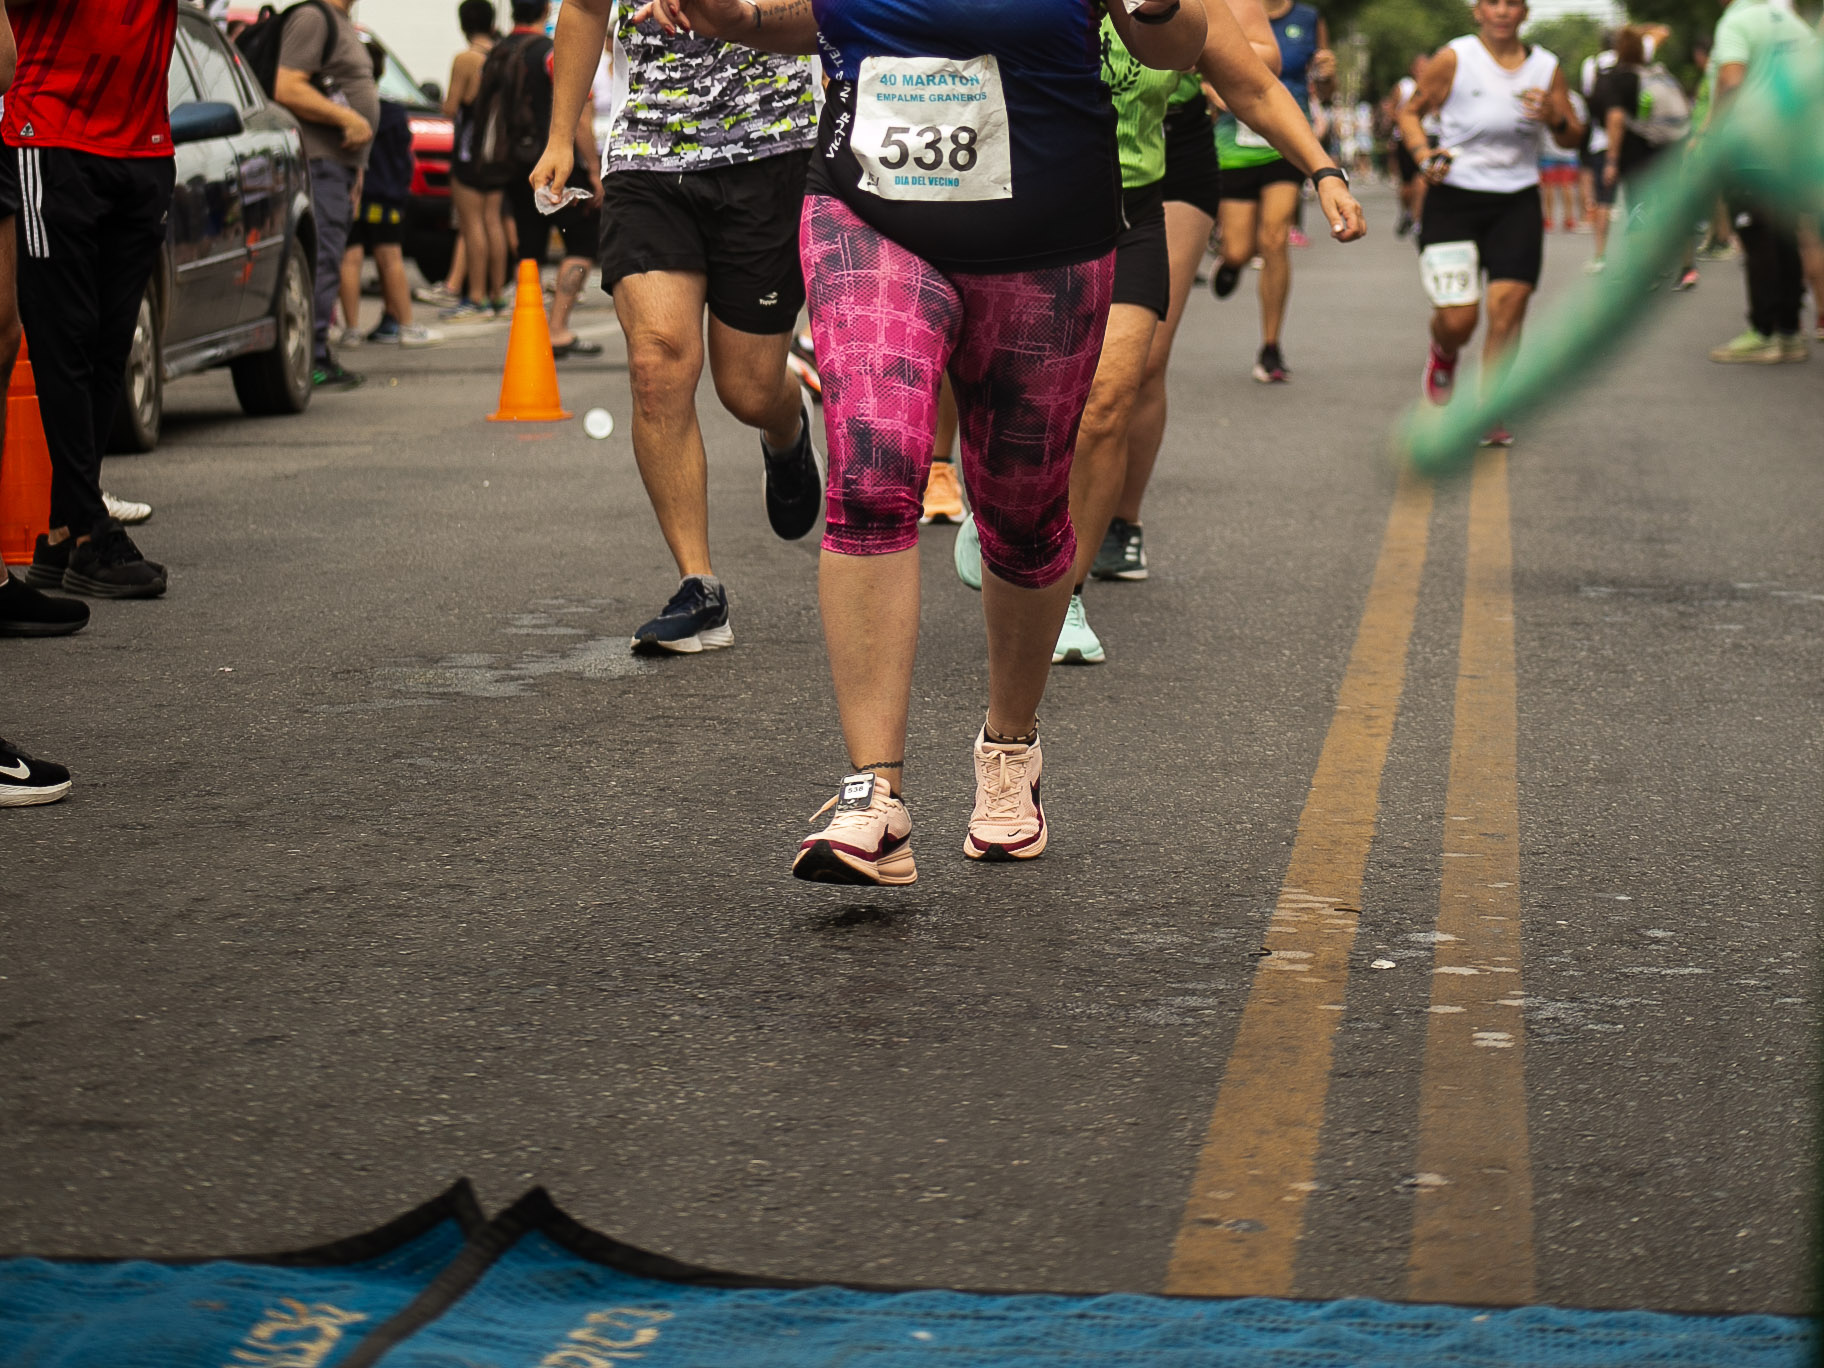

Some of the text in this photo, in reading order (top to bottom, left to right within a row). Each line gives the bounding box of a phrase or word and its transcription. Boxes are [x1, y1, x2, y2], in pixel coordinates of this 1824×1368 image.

[880, 73, 980, 87] 40 MARATON
[876, 91, 987, 103] EMPALME GRANEROS
[878, 125, 978, 172] 538
[894, 175, 960, 187] DIA DEL VECINO
[1432, 271, 1469, 291] 179
